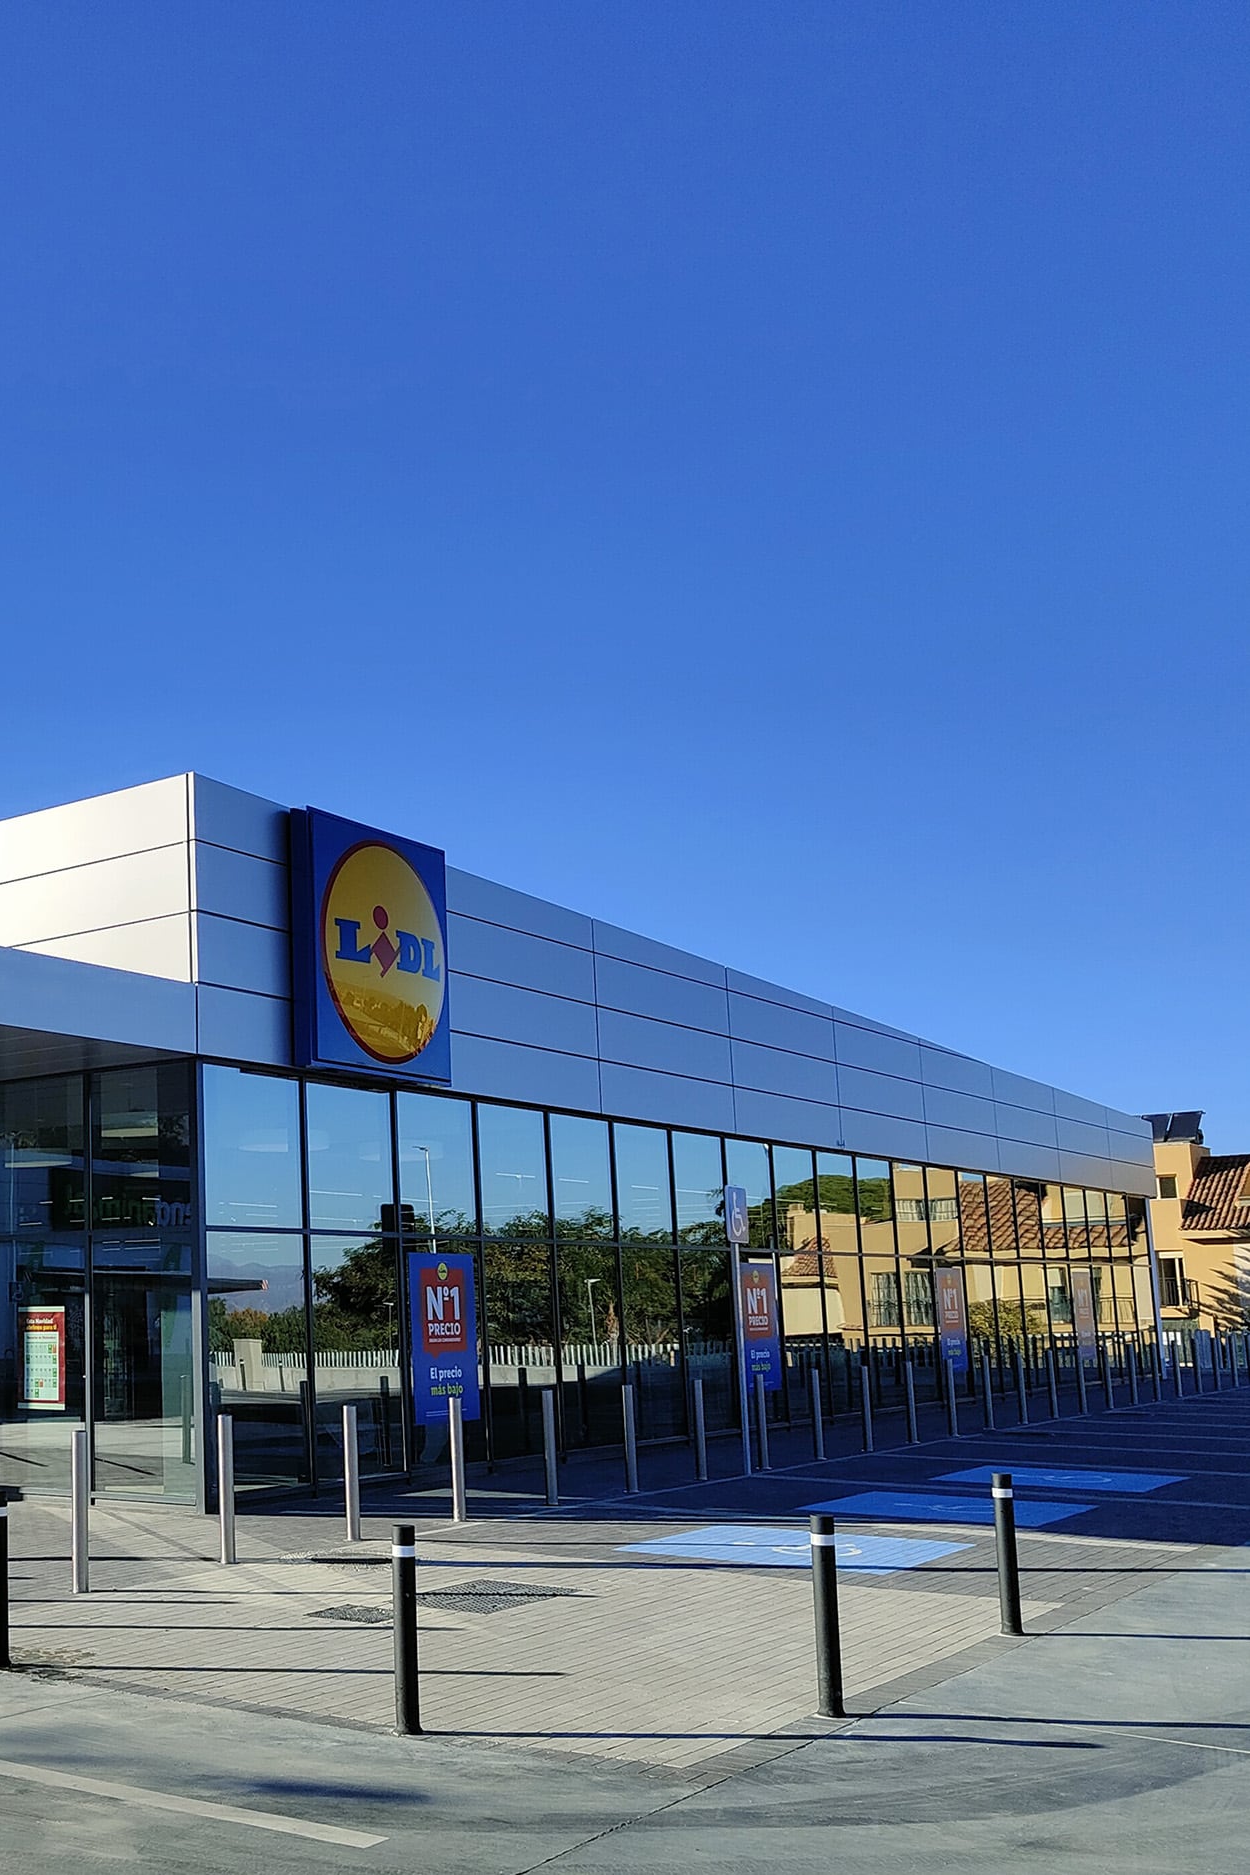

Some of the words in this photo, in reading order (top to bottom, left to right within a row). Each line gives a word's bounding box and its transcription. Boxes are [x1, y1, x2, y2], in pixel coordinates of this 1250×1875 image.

[748, 1316, 769, 1326] PRECIO
[428, 1322, 461, 1335] PRECIO
[430, 1367, 438, 1379] El
[438, 1365, 462, 1381] precio
[431, 1384, 446, 1396] más
[447, 1382, 463, 1397] bajo
